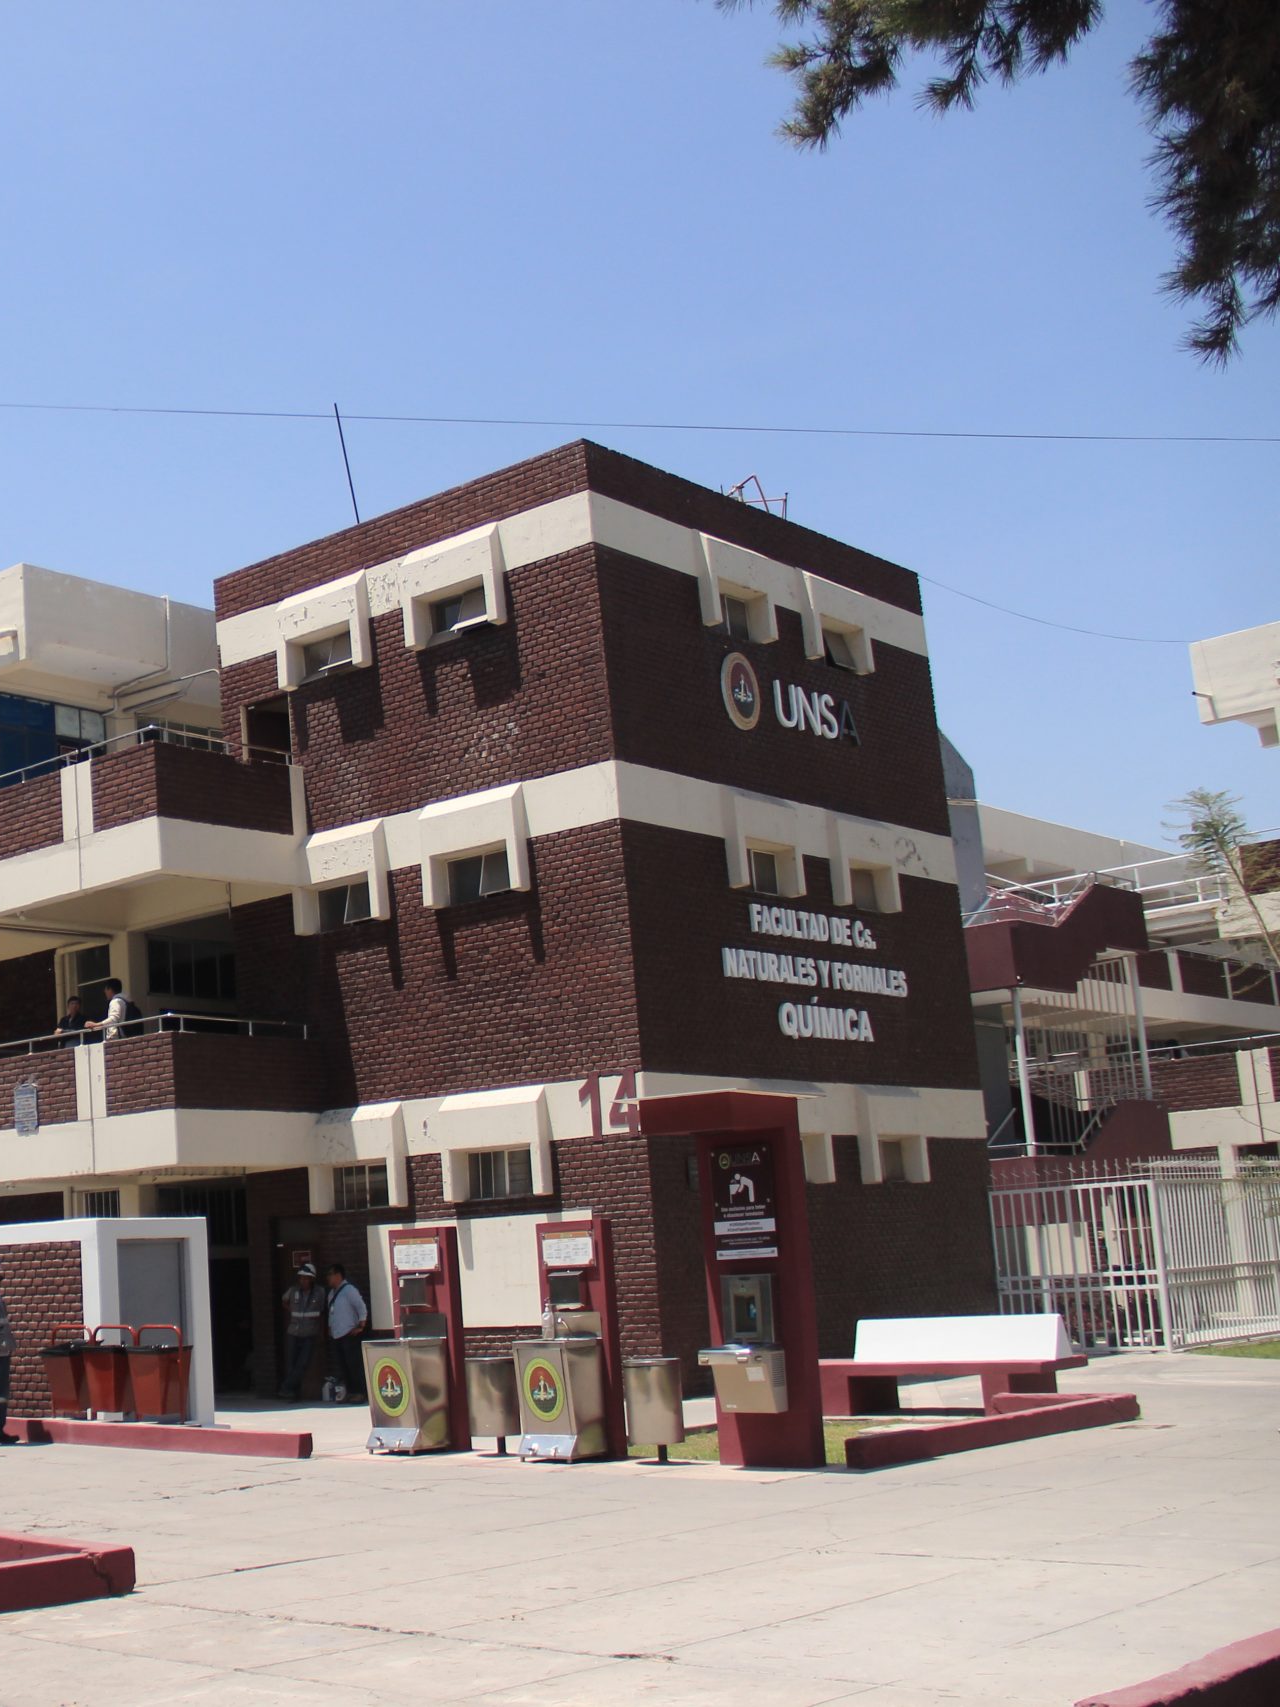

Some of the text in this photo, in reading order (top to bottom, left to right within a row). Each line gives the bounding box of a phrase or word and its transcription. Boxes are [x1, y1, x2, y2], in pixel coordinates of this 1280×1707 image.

[772, 679, 862, 746] UNSA
[748, 903, 877, 949] FACULTAD DE Cs.
[721, 947, 909, 998] NATURALES Y FORMALES
[778, 996, 875, 1042] QUÍMICA
[578, 1067, 640, 1141] 14
